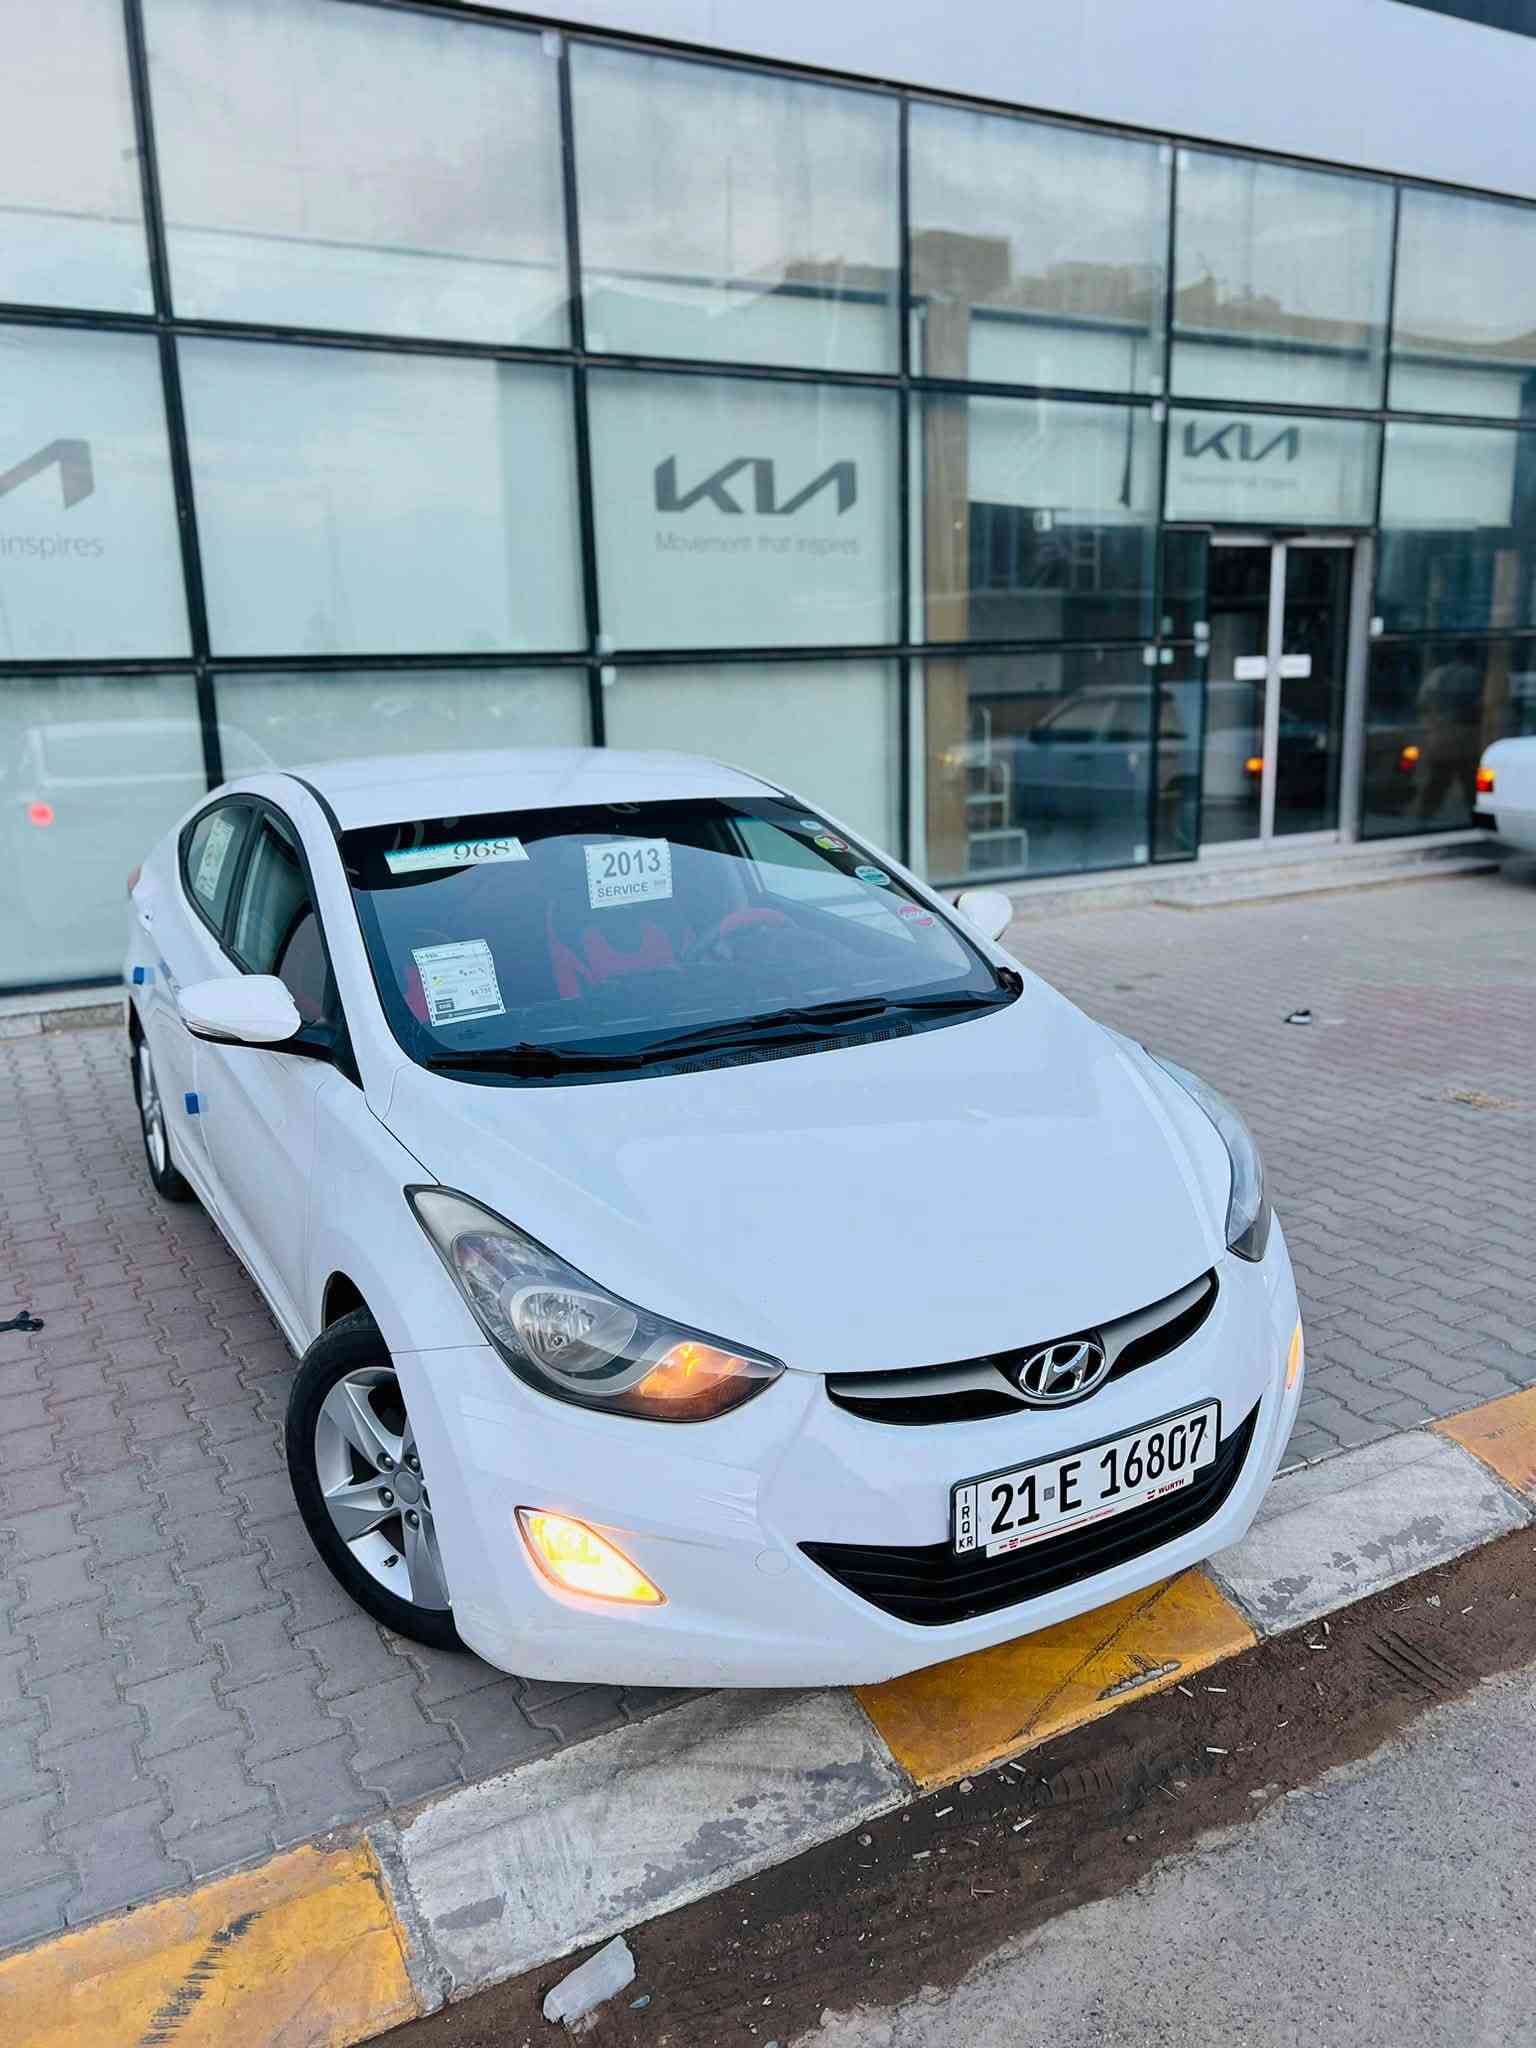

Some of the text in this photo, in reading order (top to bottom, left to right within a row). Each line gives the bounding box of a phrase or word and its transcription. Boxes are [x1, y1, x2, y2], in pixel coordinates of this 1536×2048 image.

[1183, 421, 1300, 462] KIA
[655, 455, 857, 516] KIA
[453, 840, 511, 861] 968
[602, 848, 661, 878] 2013
[598, 882, 649, 898] SERVICE
[991, 1414, 1208, 1535] 21 E 16807
